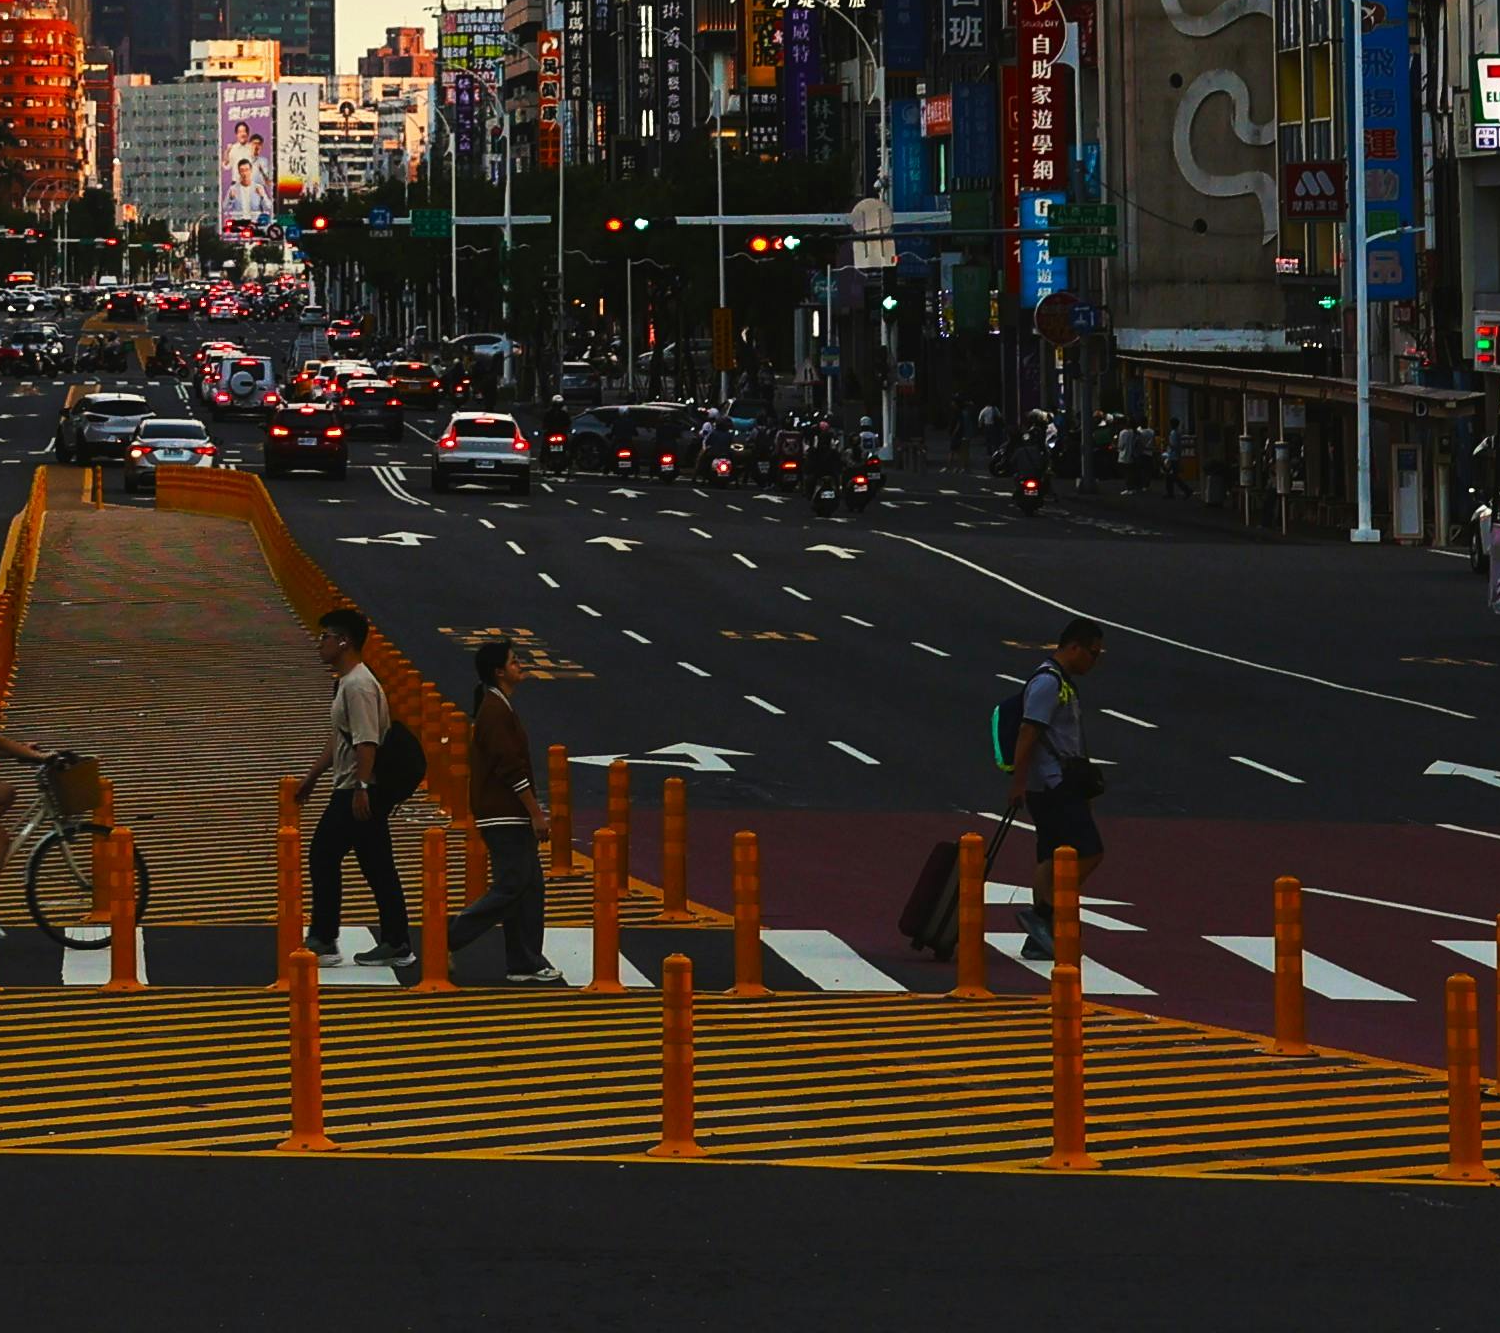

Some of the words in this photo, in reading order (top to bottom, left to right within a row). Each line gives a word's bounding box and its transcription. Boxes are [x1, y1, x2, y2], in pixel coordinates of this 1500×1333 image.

[1030, 33, 1054, 181] 自助家遊學網
